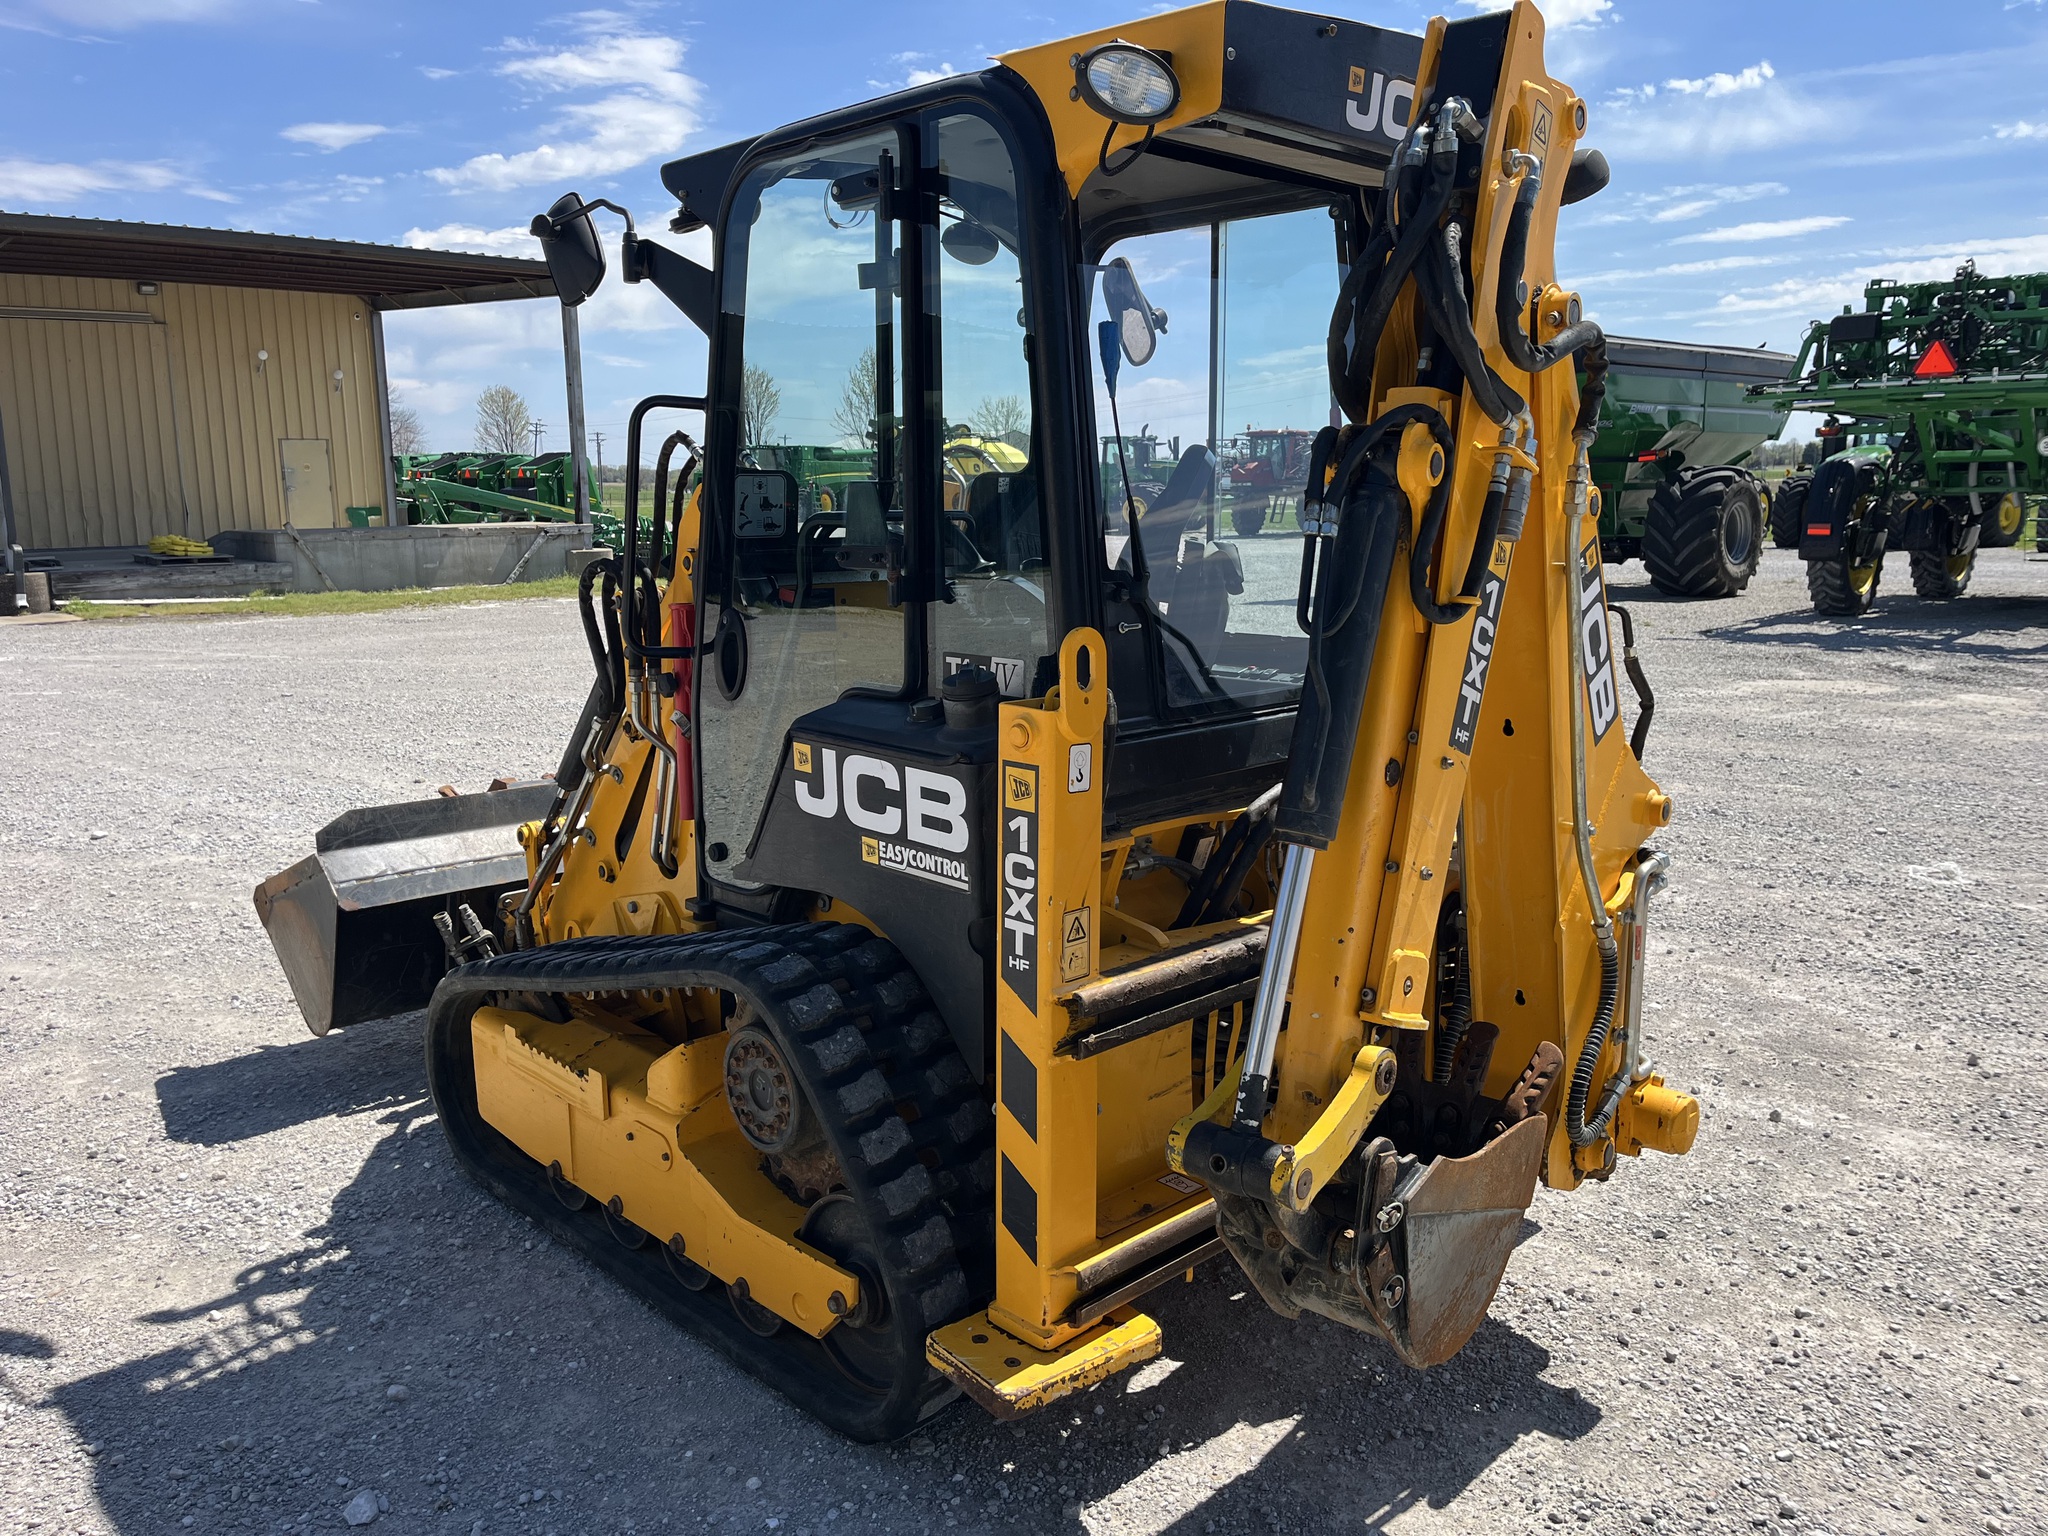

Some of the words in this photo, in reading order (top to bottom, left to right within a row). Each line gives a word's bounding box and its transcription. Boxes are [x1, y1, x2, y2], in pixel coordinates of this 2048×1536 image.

[1346, 72, 1415, 141] JC
[1461, 579, 1500, 725] 1CXT
[1455, 727, 1470, 744] HF
[795, 748, 969, 853] JCB
[1013, 778, 1031, 798] JCB
[879, 840, 969, 881] EASYCONTROL
[1004, 815, 1035, 956] 1CXT
[1009, 955, 1030, 972] HF
